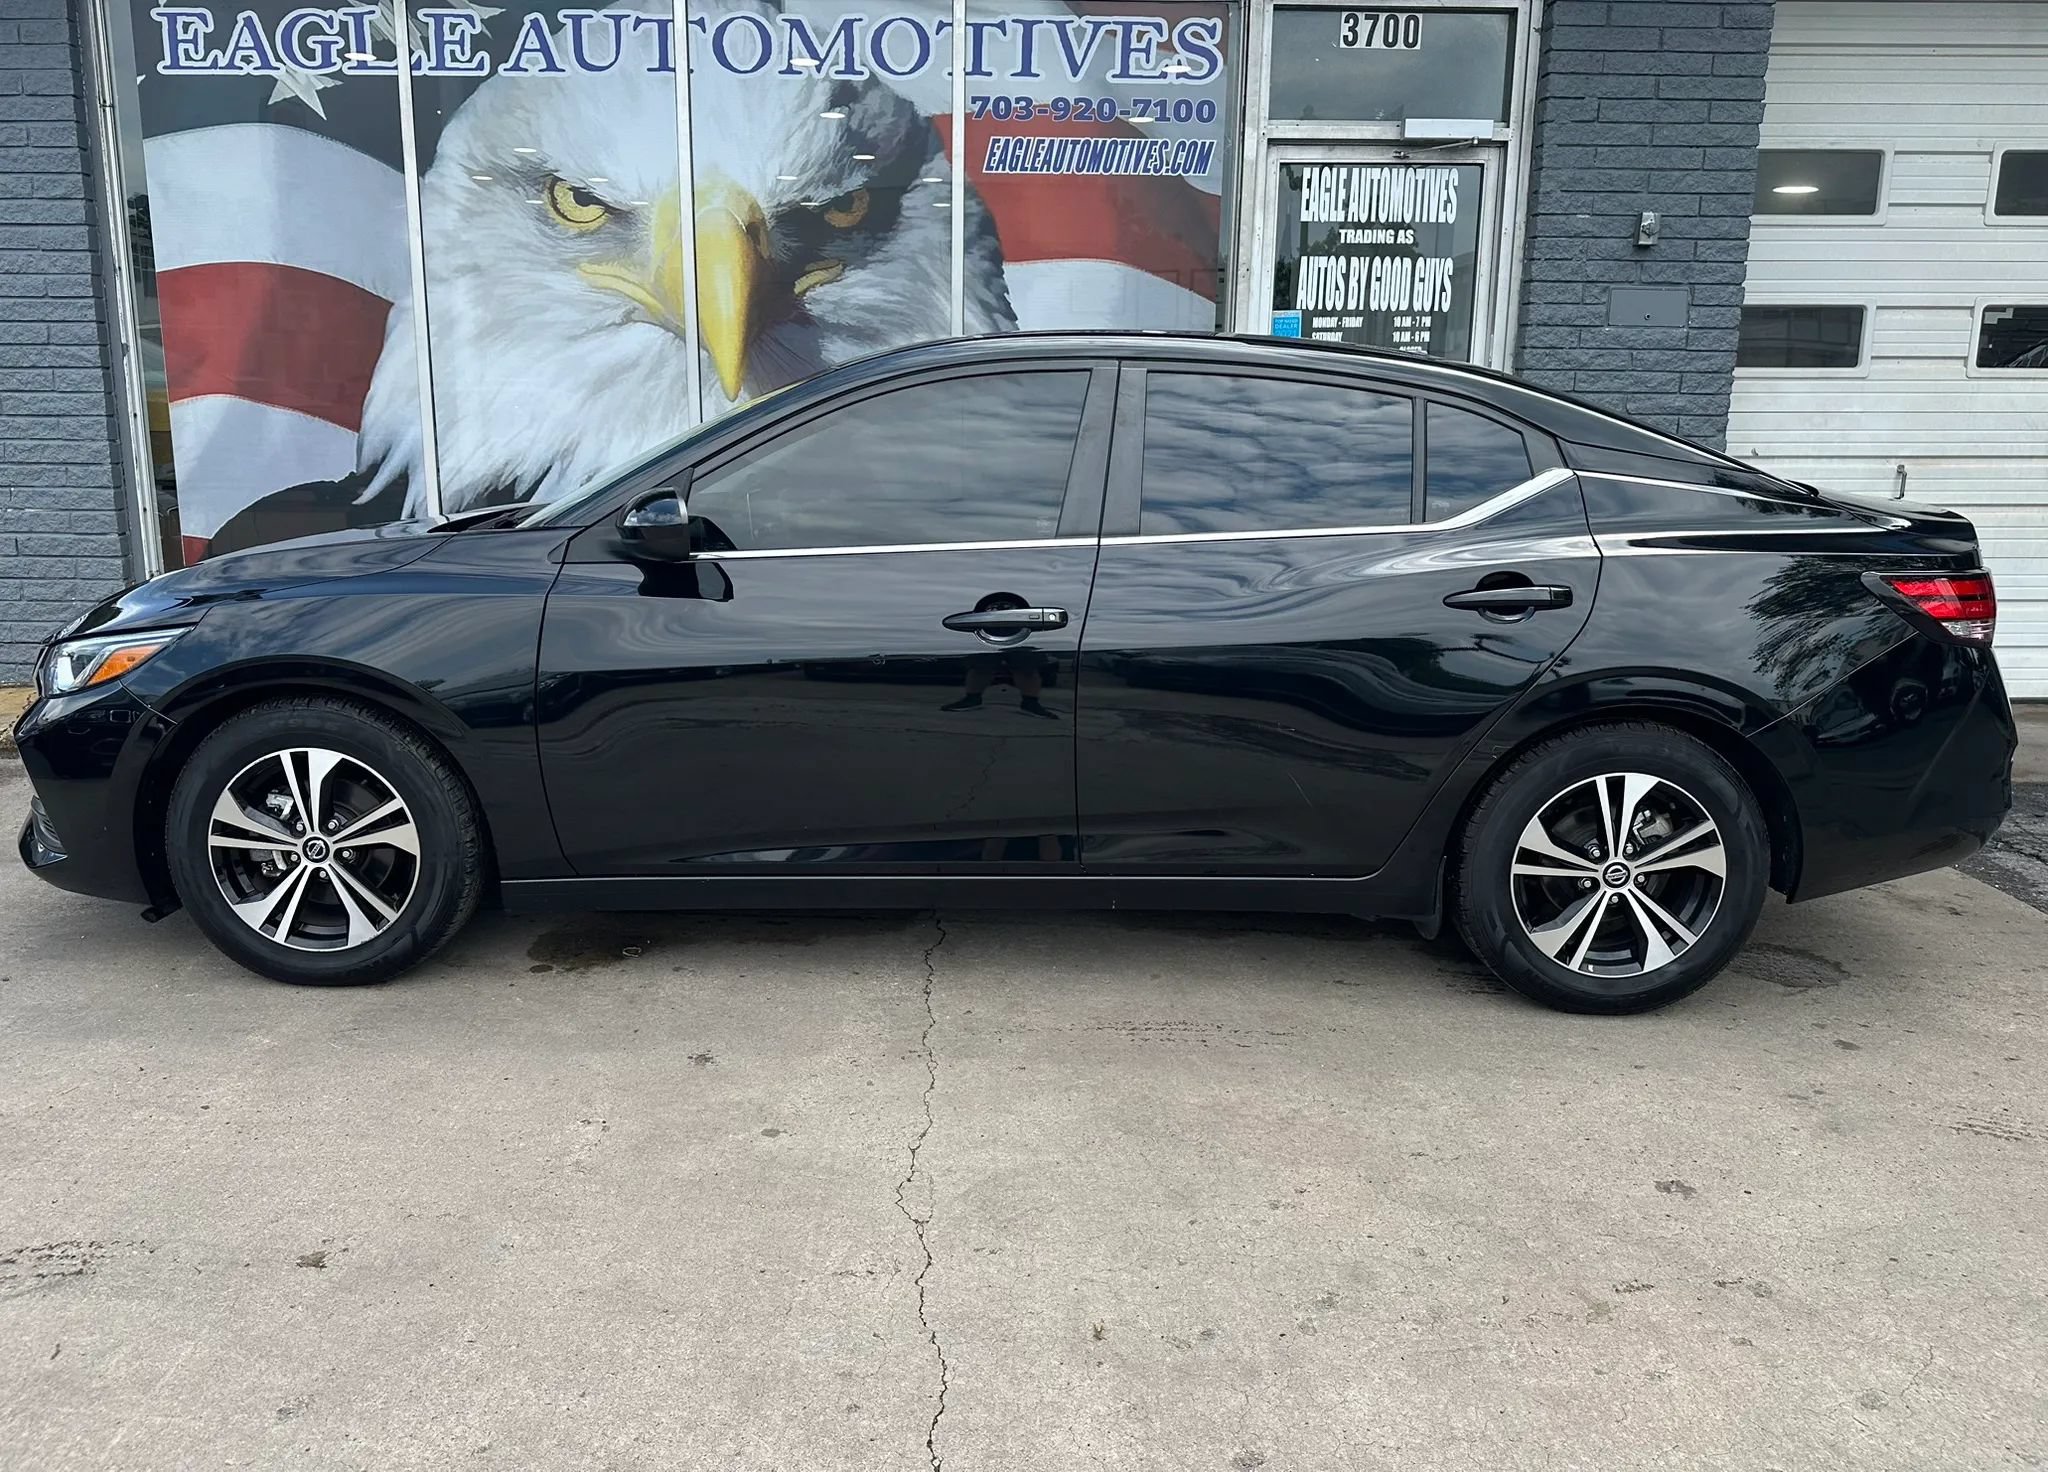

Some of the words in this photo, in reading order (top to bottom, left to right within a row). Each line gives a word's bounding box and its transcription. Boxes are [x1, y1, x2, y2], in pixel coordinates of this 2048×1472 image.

[153, 8, 488, 76] EAGLE
[501, 13, 1222, 80] AUTOMOTIVES
[1342, 12, 1420, 48] 3700
[970, 95, 1216, 124] 703-920-7100
[983, 136, 1217, 176] EAGLEAUTOMOTIVES.COM
[1300, 167, 1348, 223] EAGLE
[1348, 167, 1459, 224] AUTOMOTIVES
[1339, 229, 1394, 244] TRADING
[1397, 229, 1414, 244] AS
[1296, 255, 1347, 311] AUTOS
[1347, 256, 1370, 311] BY
[1370, 256, 1412, 312] GOOD
[1413, 256, 1454, 313] GUYS
[1311, 331, 1343, 342] SATURDAY
[1392, 331, 1400, 342] 10
[1400, 331, 1411, 342] AM
[1420, 331, 1431, 342] PM
[1312, 316, 1338, 328] MONDAY
[1342, 316, 1364, 328] FRIDAY
[1393, 316, 1401, 328] 10
[1401, 316, 1412, 328] AM
[1421, 316, 1432, 328] PM
